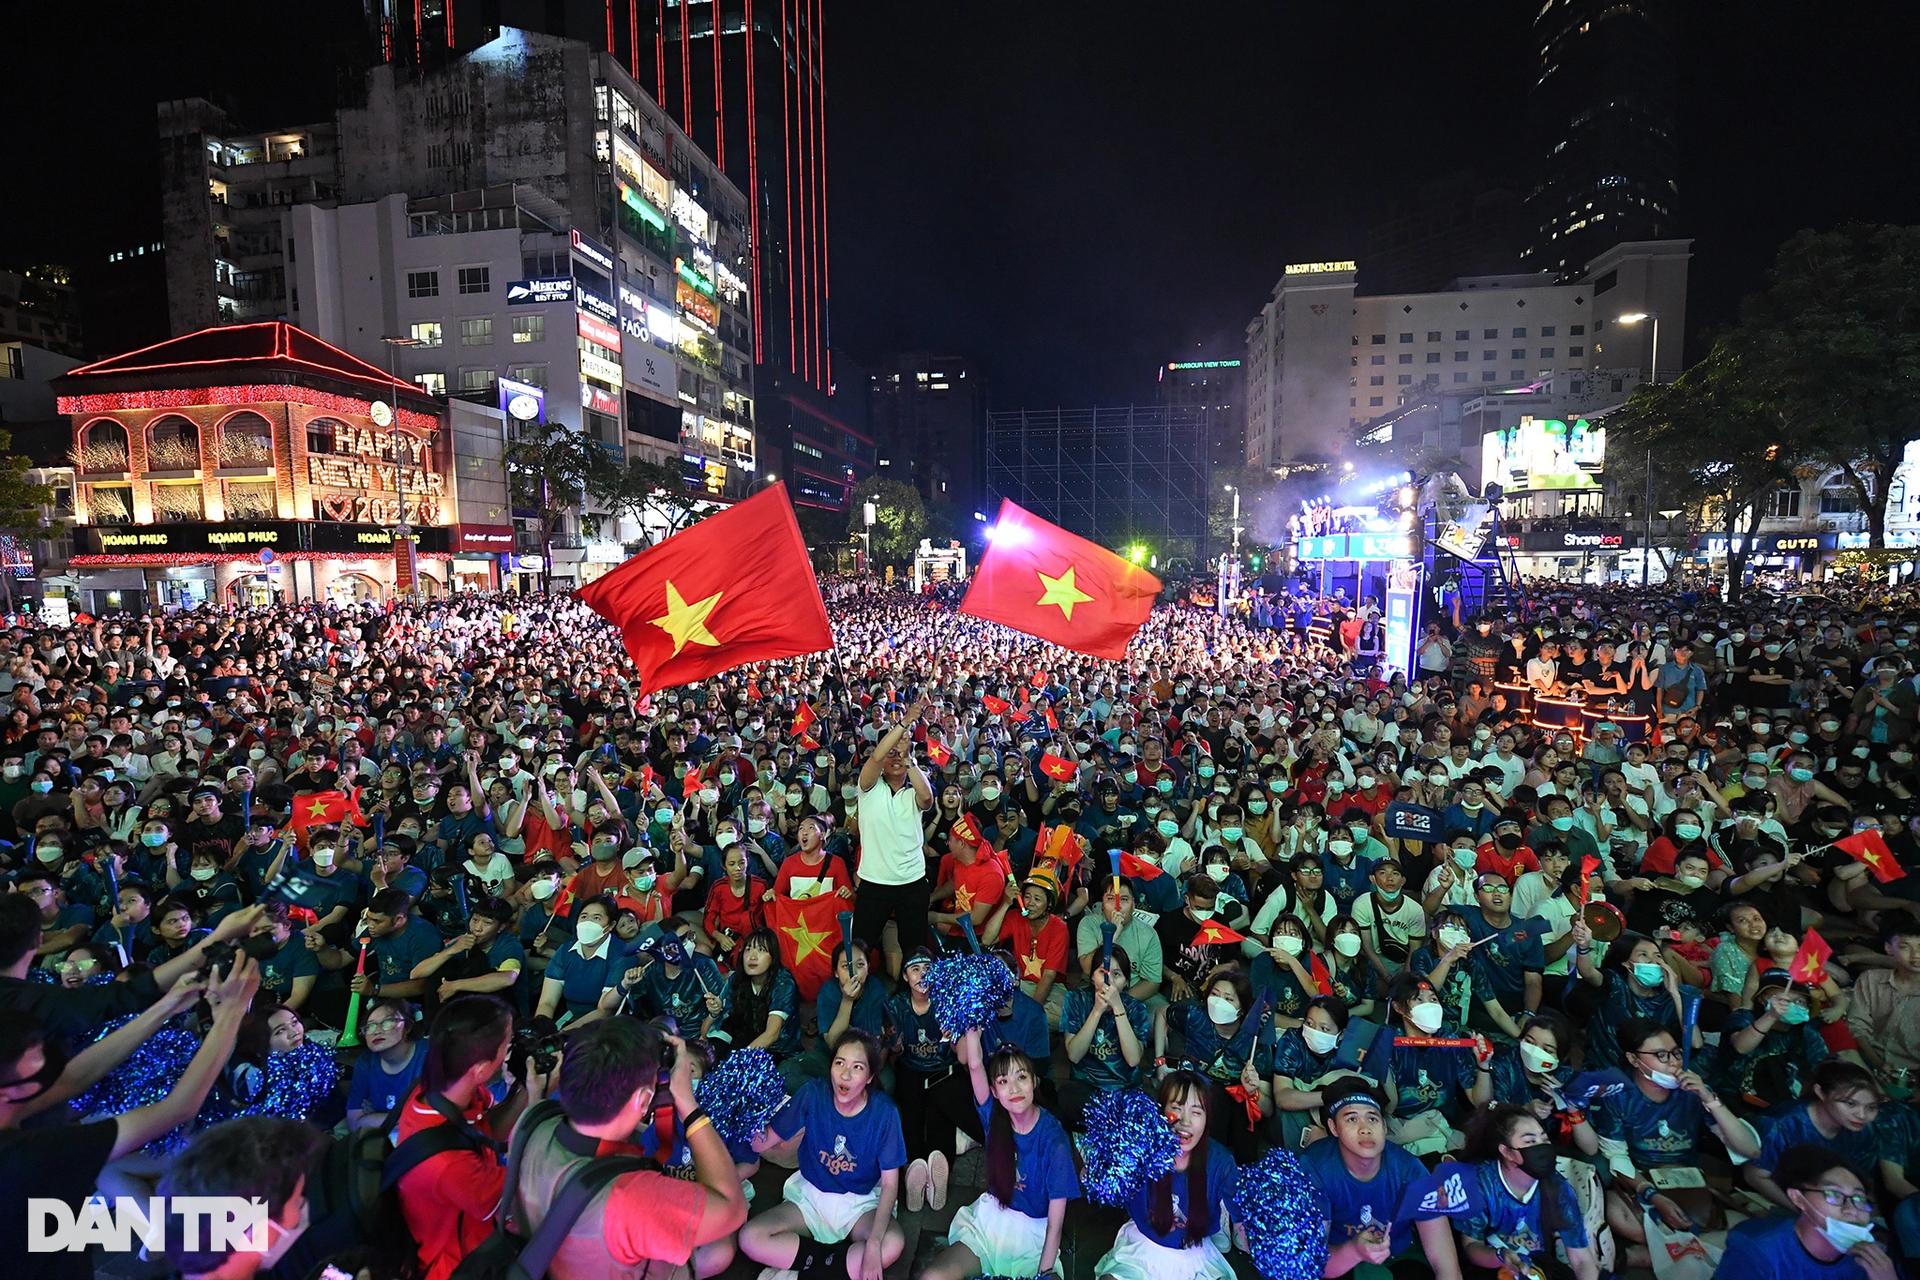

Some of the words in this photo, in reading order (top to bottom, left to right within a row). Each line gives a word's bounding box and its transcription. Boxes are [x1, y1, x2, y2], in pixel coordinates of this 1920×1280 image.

[1285, 263, 1309, 274] SAIGON
[1335, 261, 1357, 271] HOTEL
[530, 280, 572, 293] MEKONG
[552, 293, 568, 301] STOP
[621, 316, 649, 342] FADO
[335, 425, 424, 463] HAPPY
[310, 457, 372, 488] NEW
[377, 465, 445, 496] YEAR
[355, 497, 419, 526] 2022
[103, 534, 138, 546] HOANG
[139, 533, 168, 545] PHUC
[208, 532, 246, 543] HOANG
[247, 530, 278, 543] PHUC
[357, 533, 391, 544] HOANG
[1564, 533, 1622, 546] Sharetea
[1776, 538, 1818, 550] GUTA
[1332, 885, 1355, 900] Tiger
[663, 1004, 694, 1018] Tiger
[909, 1042, 938, 1059] Tiger
[1405, 1085, 1444, 1103] Tiger
[1643, 1137, 1692, 1153] Tiger
[819, 1149, 858, 1176] Tiger
[666, 1163, 696, 1181] Tige
